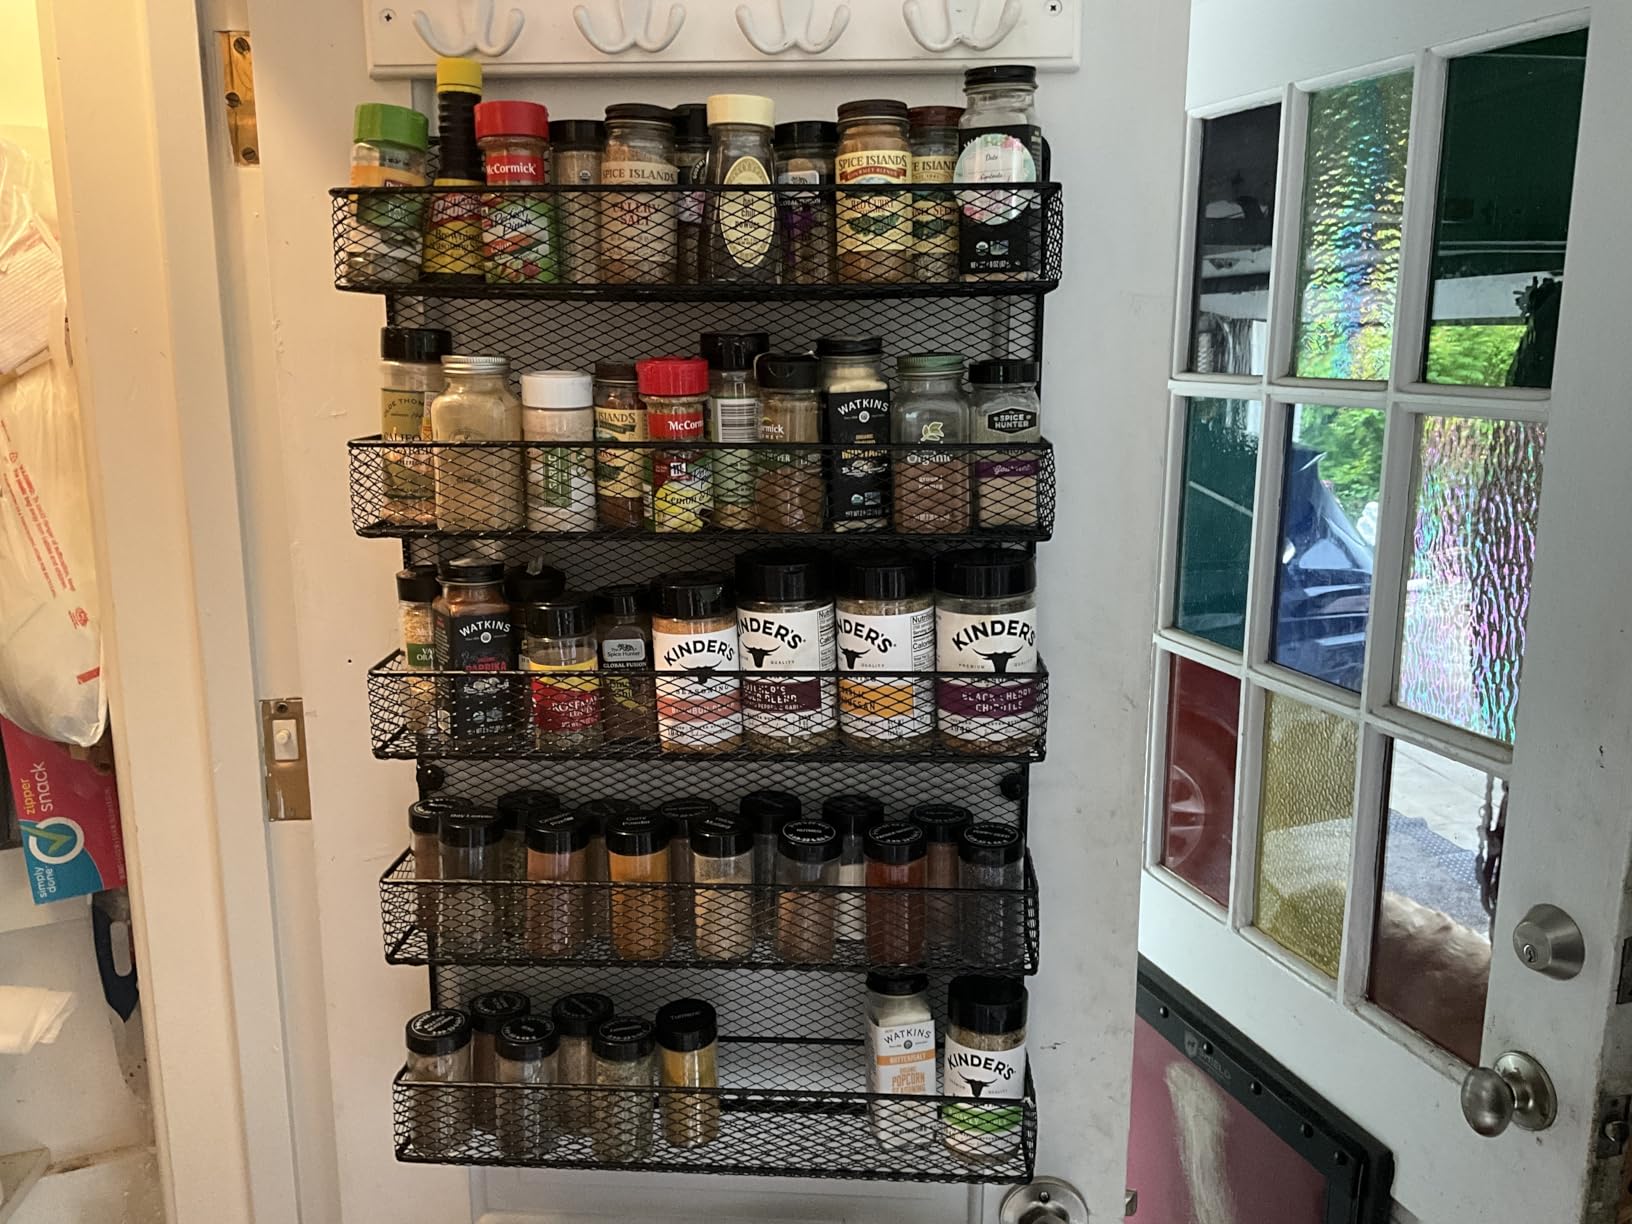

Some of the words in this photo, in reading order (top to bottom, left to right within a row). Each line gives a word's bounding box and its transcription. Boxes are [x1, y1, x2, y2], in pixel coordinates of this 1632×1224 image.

[602, 168, 625, 179] SPICE
[629, 168, 674, 182] ISLANDS
[839, 156, 864, 170] SPICE
[866, 154, 907, 168] ISLANDS
[838, 398, 889, 415] WATKINS
[459, 620, 511, 637] WATKINS
[836, 618, 893, 653] NDER'S
[951, 619, 1036, 651] KINDER'S
[663, 639, 736, 667] KINDER'S
[20, 778, 36, 815] zipper
[30, 760, 54, 812] snack
[33, 866, 48, 898] simply
[45, 868, 57, 893] done
[883, 1028, 932, 1044] WATKINS
[891, 1071, 925, 1087] POPCORN
[947, 1053, 1014, 1080] KINDER'S
